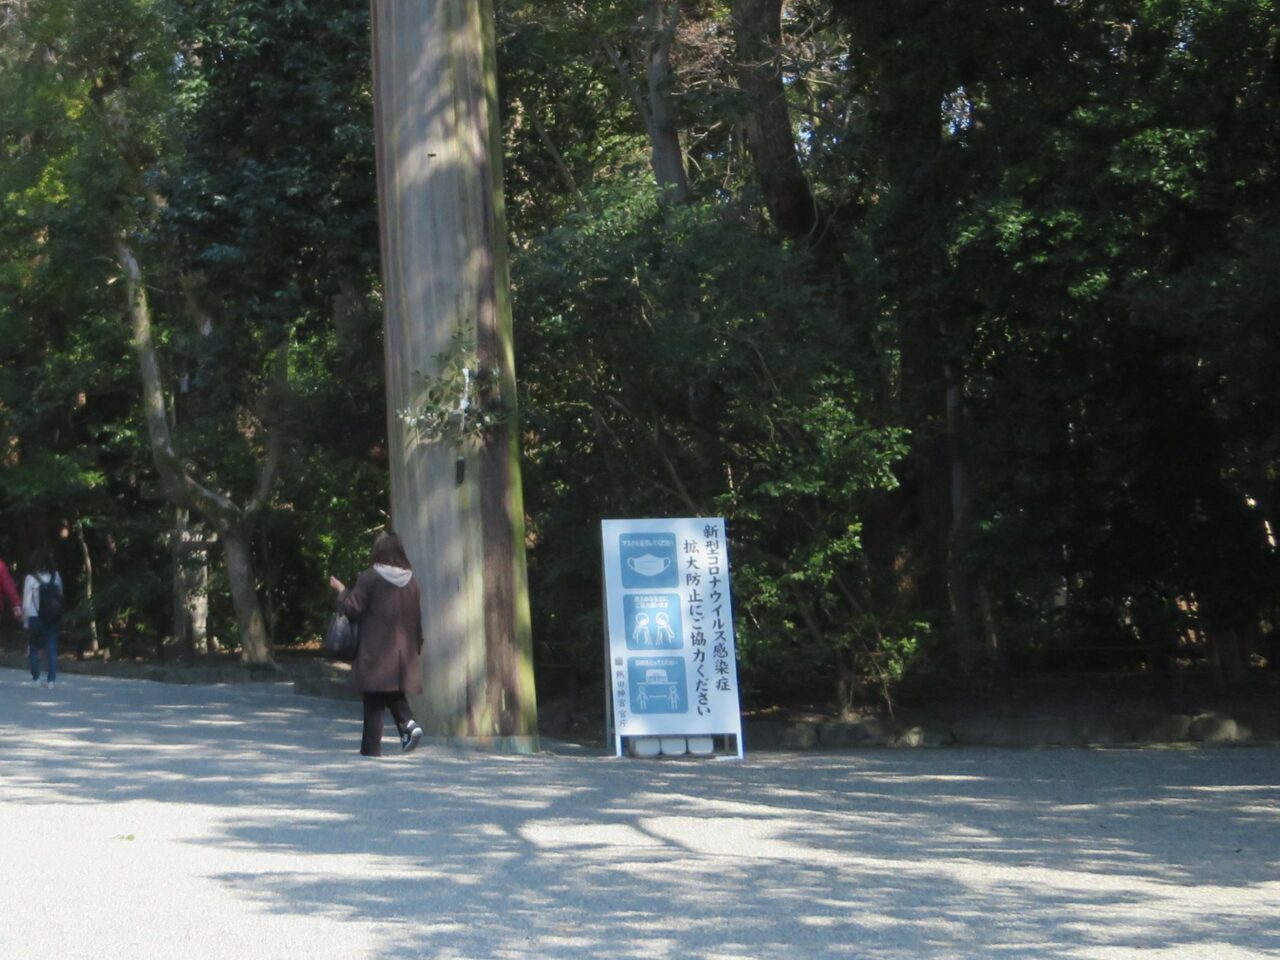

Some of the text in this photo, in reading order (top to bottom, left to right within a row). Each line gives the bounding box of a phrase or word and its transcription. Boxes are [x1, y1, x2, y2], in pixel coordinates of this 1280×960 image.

[684, 540, 711, 716] 拡大防止にご協力ください
[703, 524, 731, 691] 新型コロナウイルス感染症
